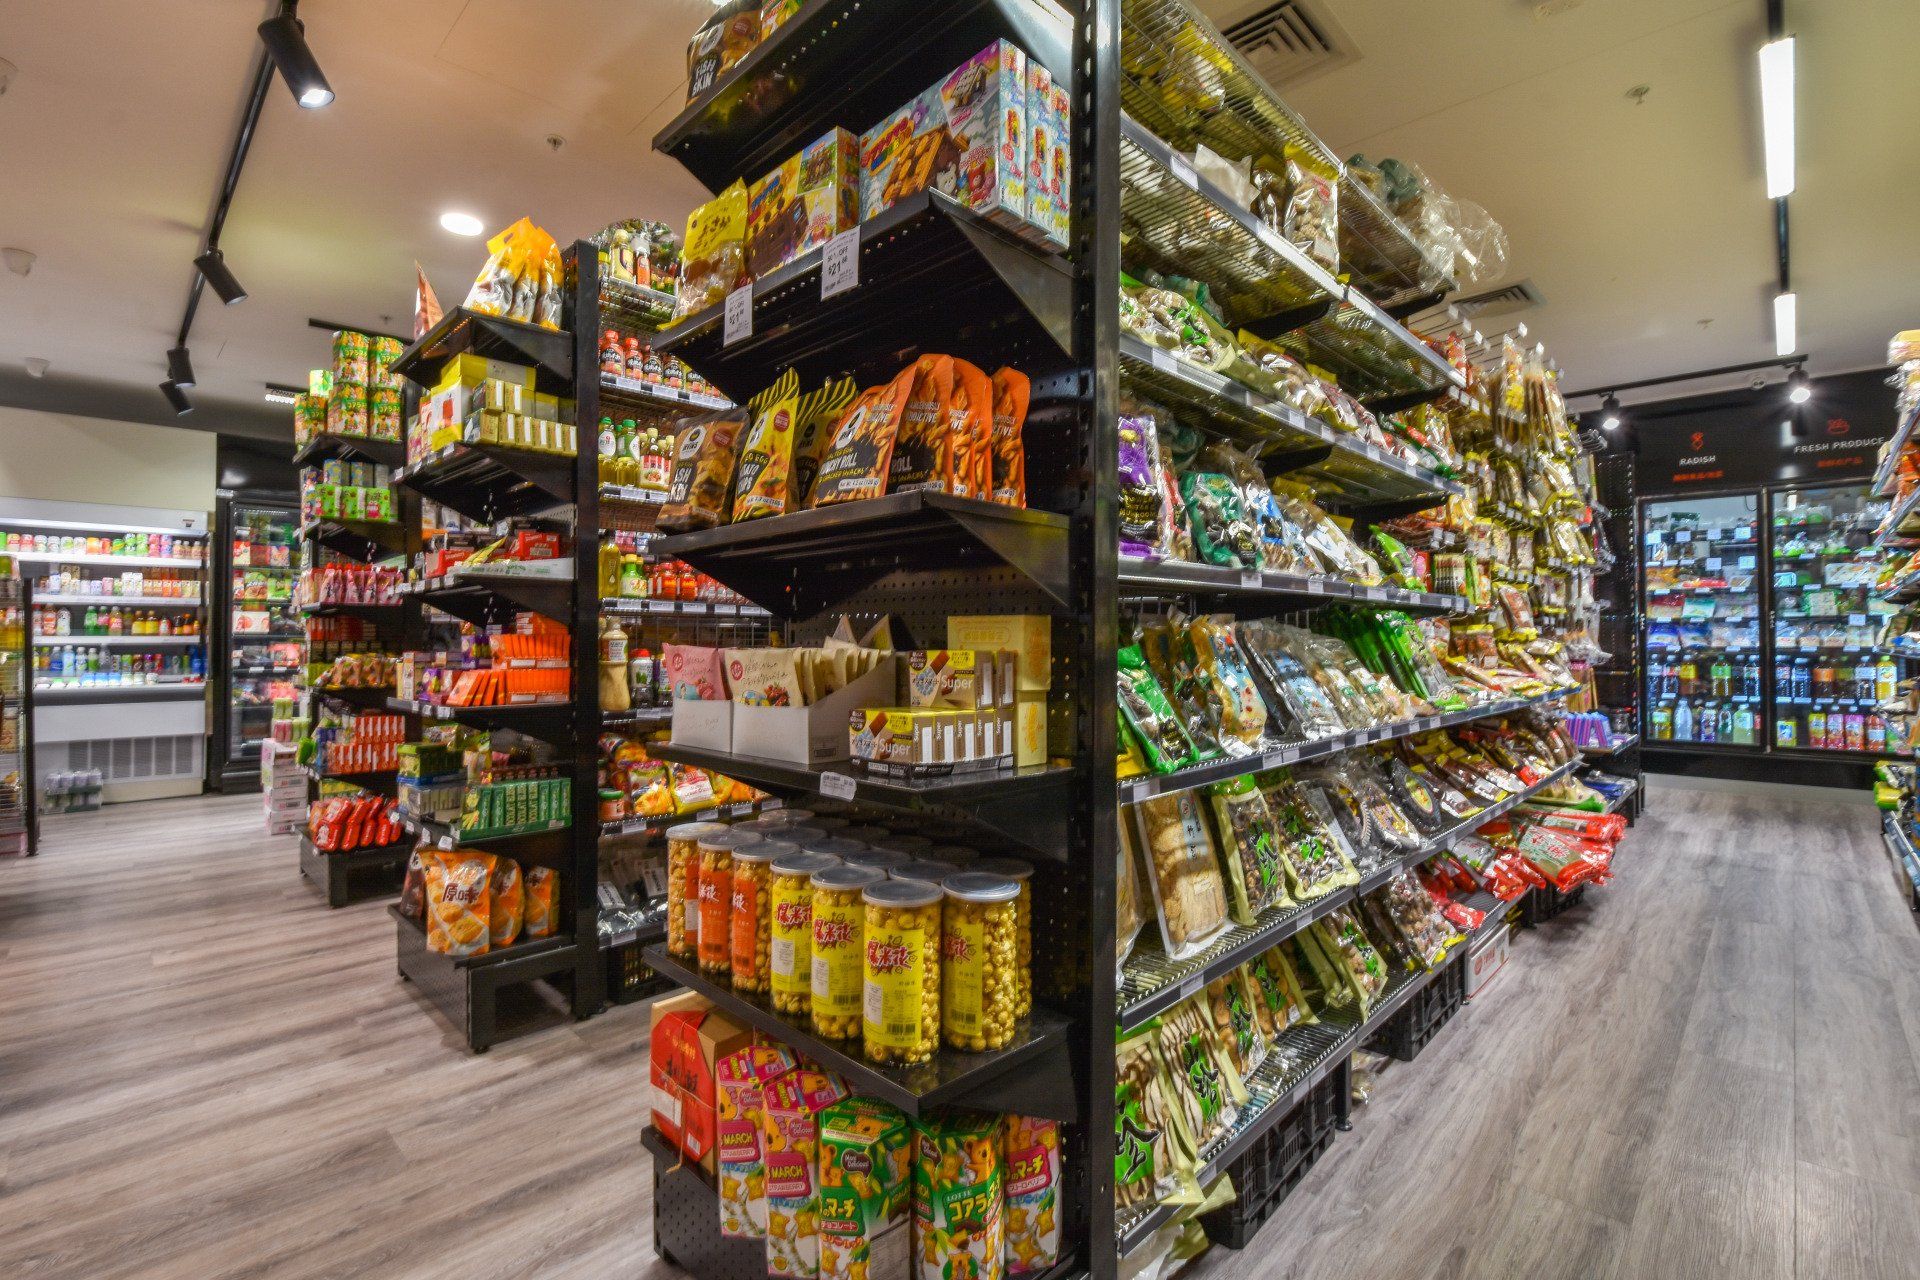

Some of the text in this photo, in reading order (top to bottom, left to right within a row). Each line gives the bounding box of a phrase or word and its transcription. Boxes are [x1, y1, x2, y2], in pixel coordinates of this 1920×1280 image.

[1794, 437, 1885, 454] FRESH PRODUCE
[1679, 455, 1716, 466] RADISH
[941, 674, 973, 692] Super
[878, 738, 911, 757] Super
[443, 883, 480, 903] 原味
[724, 1132, 753, 1146] MARCH
[772, 1165, 803, 1179] MARCH
[947, 1188, 972, 1202] LOTTE
